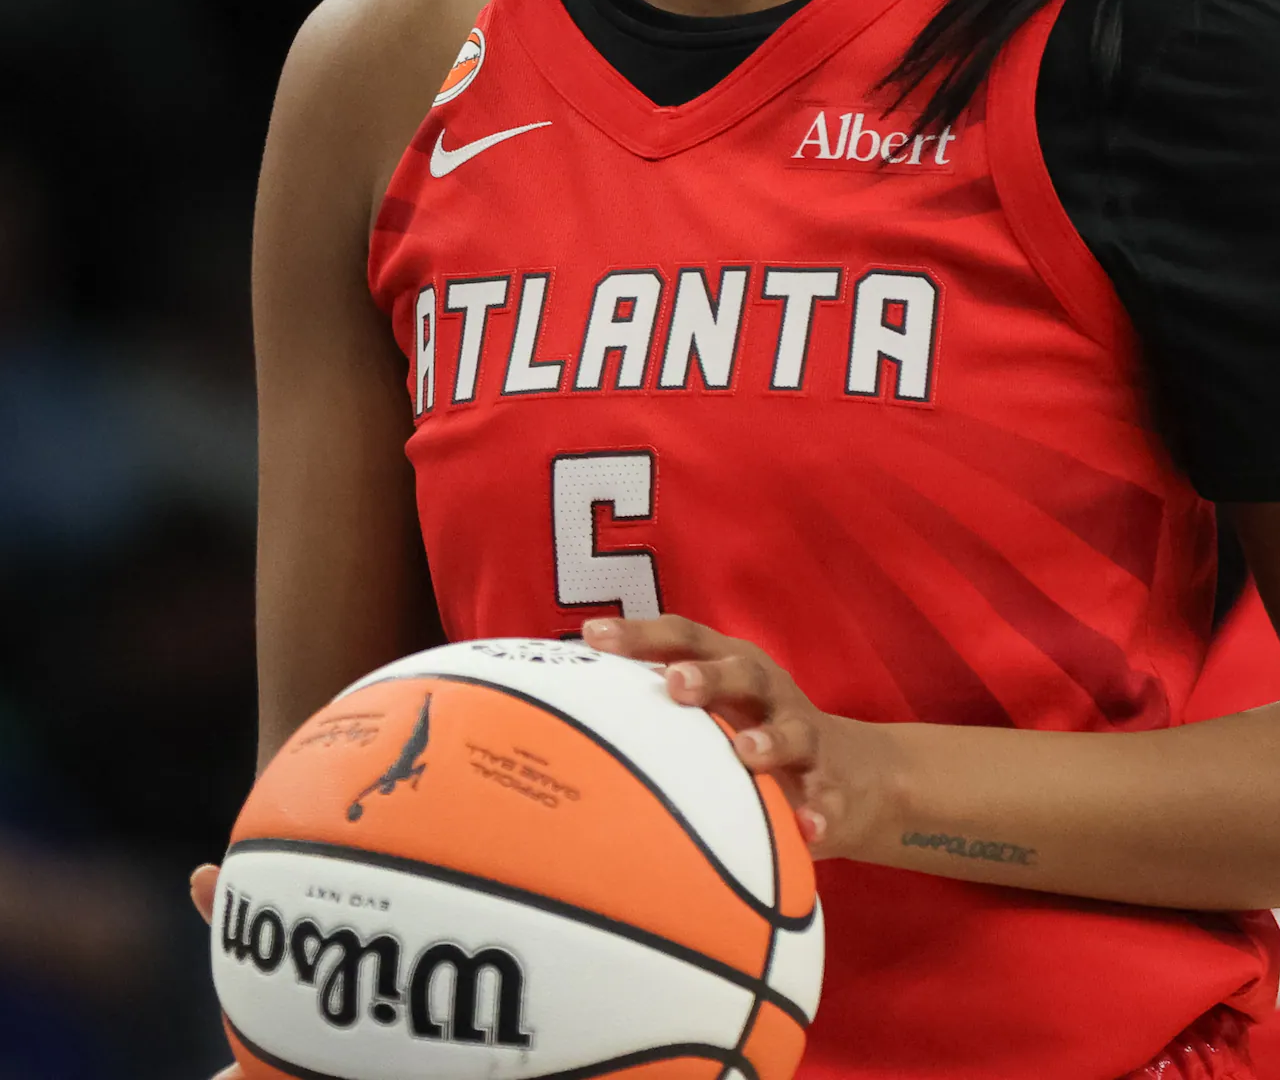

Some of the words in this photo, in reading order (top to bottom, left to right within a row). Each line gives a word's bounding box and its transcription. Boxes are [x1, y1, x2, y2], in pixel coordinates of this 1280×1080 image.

[791, 110, 957, 166] Albert
[415, 265, 938, 417] ATLANTA
[551, 450, 664, 639] 5
[464, 741, 517, 772] BALL
[468, 762, 559, 809] OFFICIAL
[519, 765, 581, 802] GAME
[303, 884, 342, 906] NXT
[348, 894, 391, 912] EVO
[221, 884, 534, 1051] Wilson
